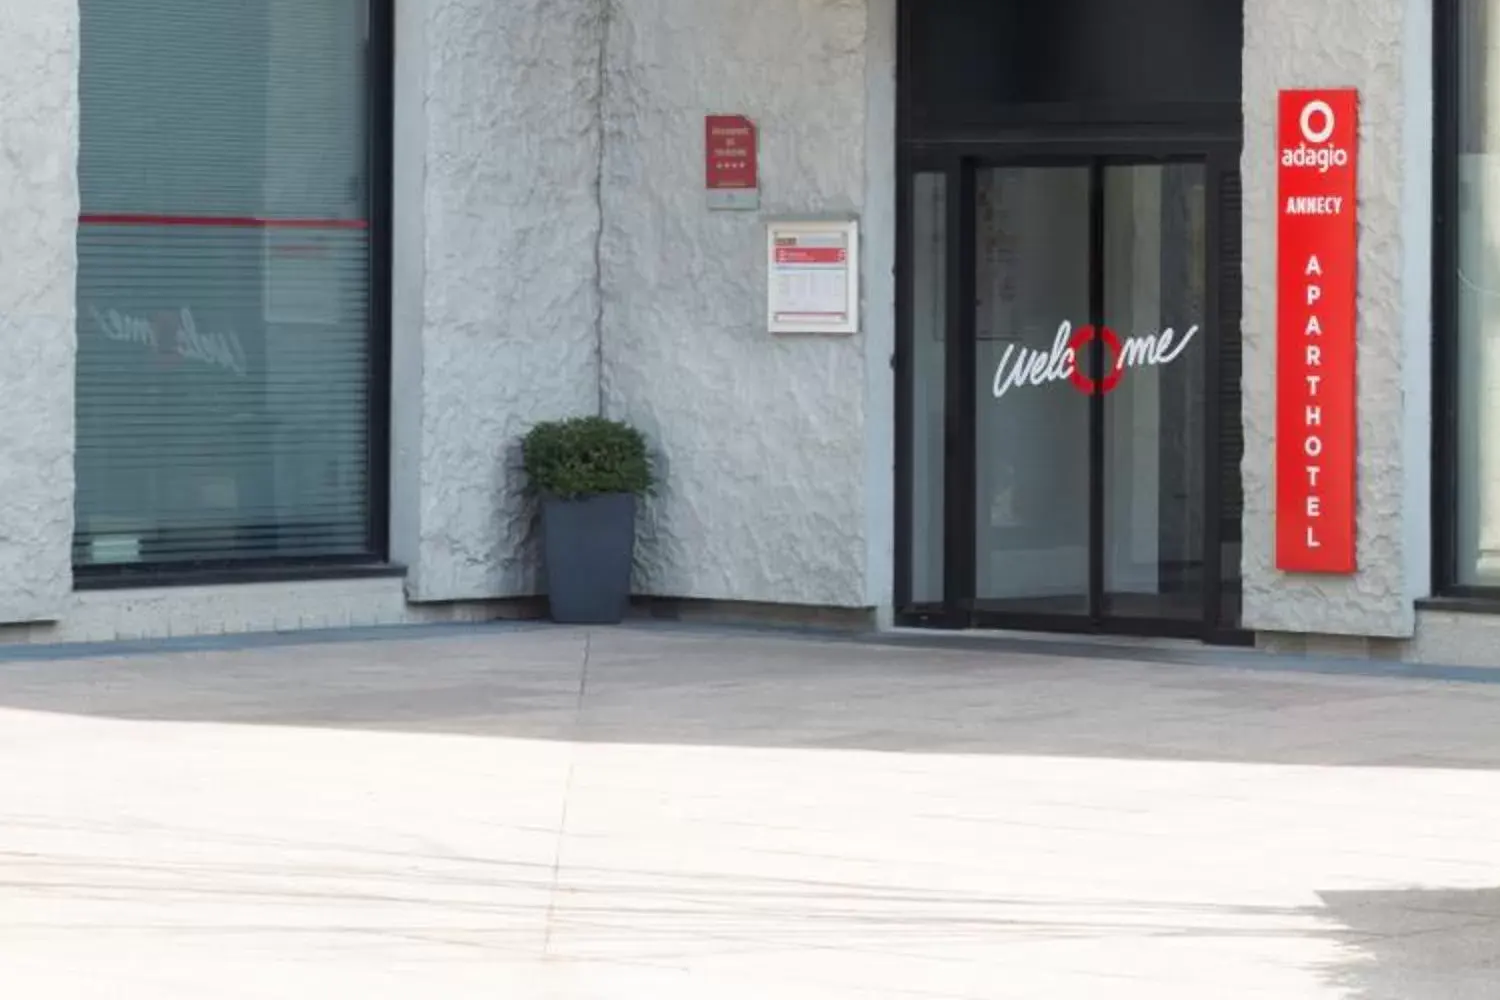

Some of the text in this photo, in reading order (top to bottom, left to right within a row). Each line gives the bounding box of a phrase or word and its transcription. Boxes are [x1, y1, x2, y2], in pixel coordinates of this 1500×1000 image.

[1281, 144, 1347, 172] adagio
[1286, 196, 1343, 214] ANNECY
[1304, 255, 1322, 547] APARTHOTEL
